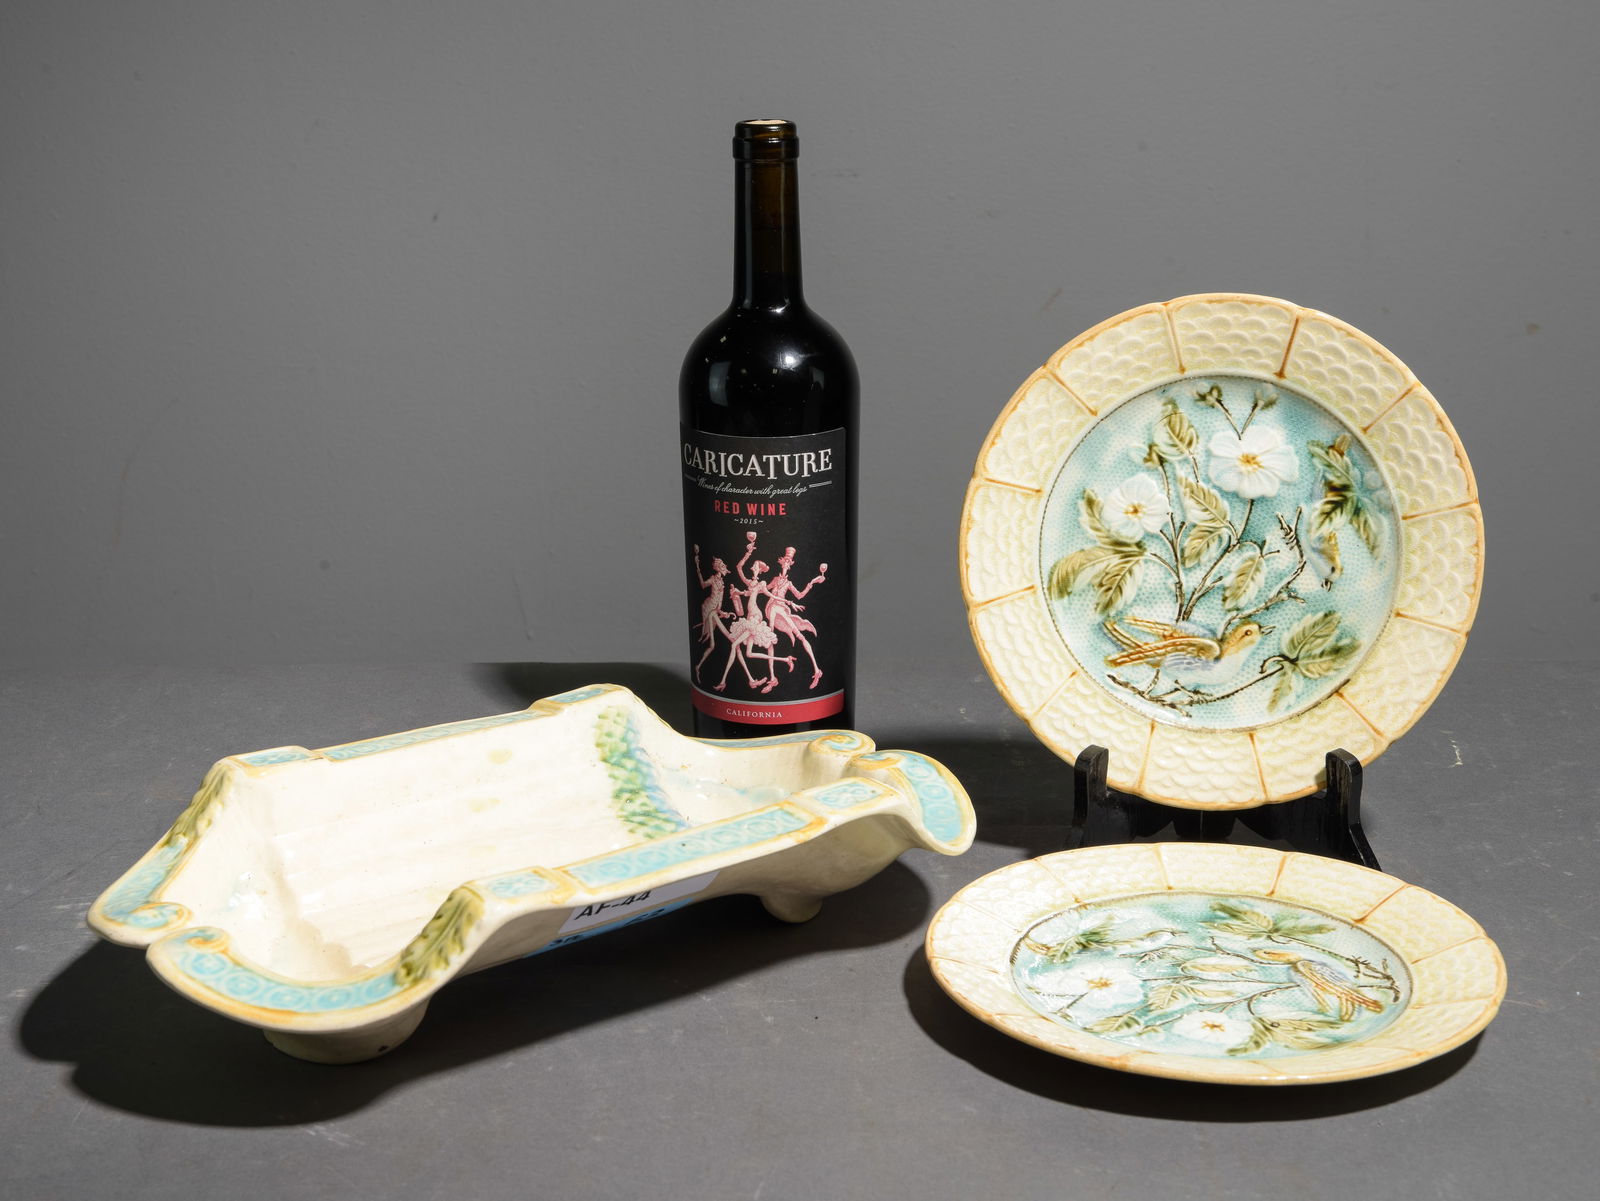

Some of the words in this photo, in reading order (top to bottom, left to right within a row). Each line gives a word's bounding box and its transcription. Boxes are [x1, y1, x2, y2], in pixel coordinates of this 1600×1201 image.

[684, 442, 833, 480] CARICATURE
[697, 476, 714, 490] Wines
[714, 482, 725, 494] of
[721, 483, 753, 494] character
[753, 484, 774, 495] with
[769, 486, 793, 499] great
[792, 483, 808, 497] legs
[714, 499, 740, 515] RED
[746, 502, 787, 516] WINE
[726, 708, 783, 718] CALIFORNIA
